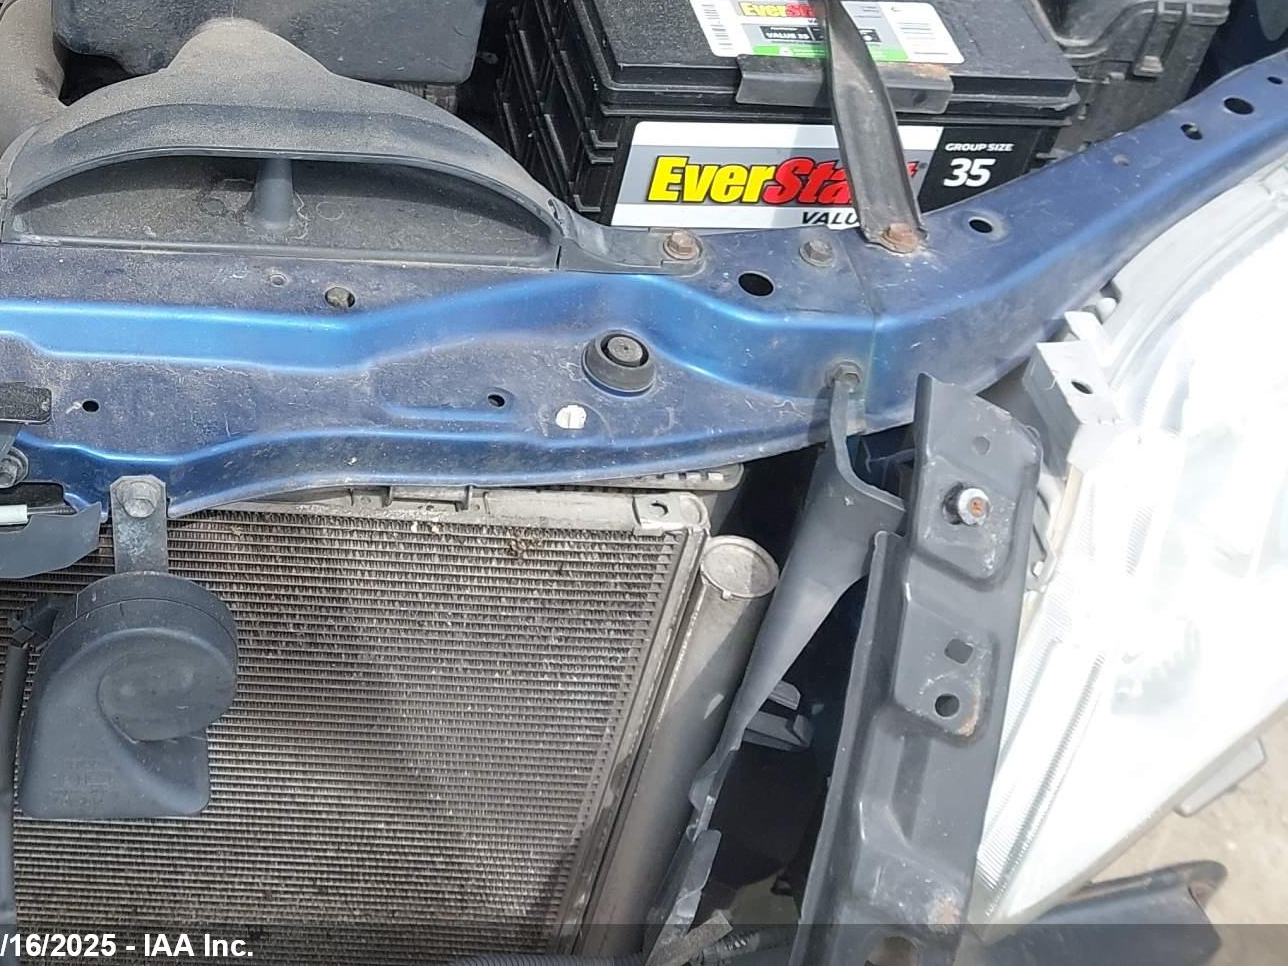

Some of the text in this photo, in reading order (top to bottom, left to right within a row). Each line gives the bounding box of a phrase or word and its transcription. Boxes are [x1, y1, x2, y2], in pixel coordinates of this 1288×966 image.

[944, 142, 1015, 152] GROUP SIZE
[646, 155, 920, 206] EverSta
[943, 157, 997, 188] 35
[800, 211, 860, 226] VALU
